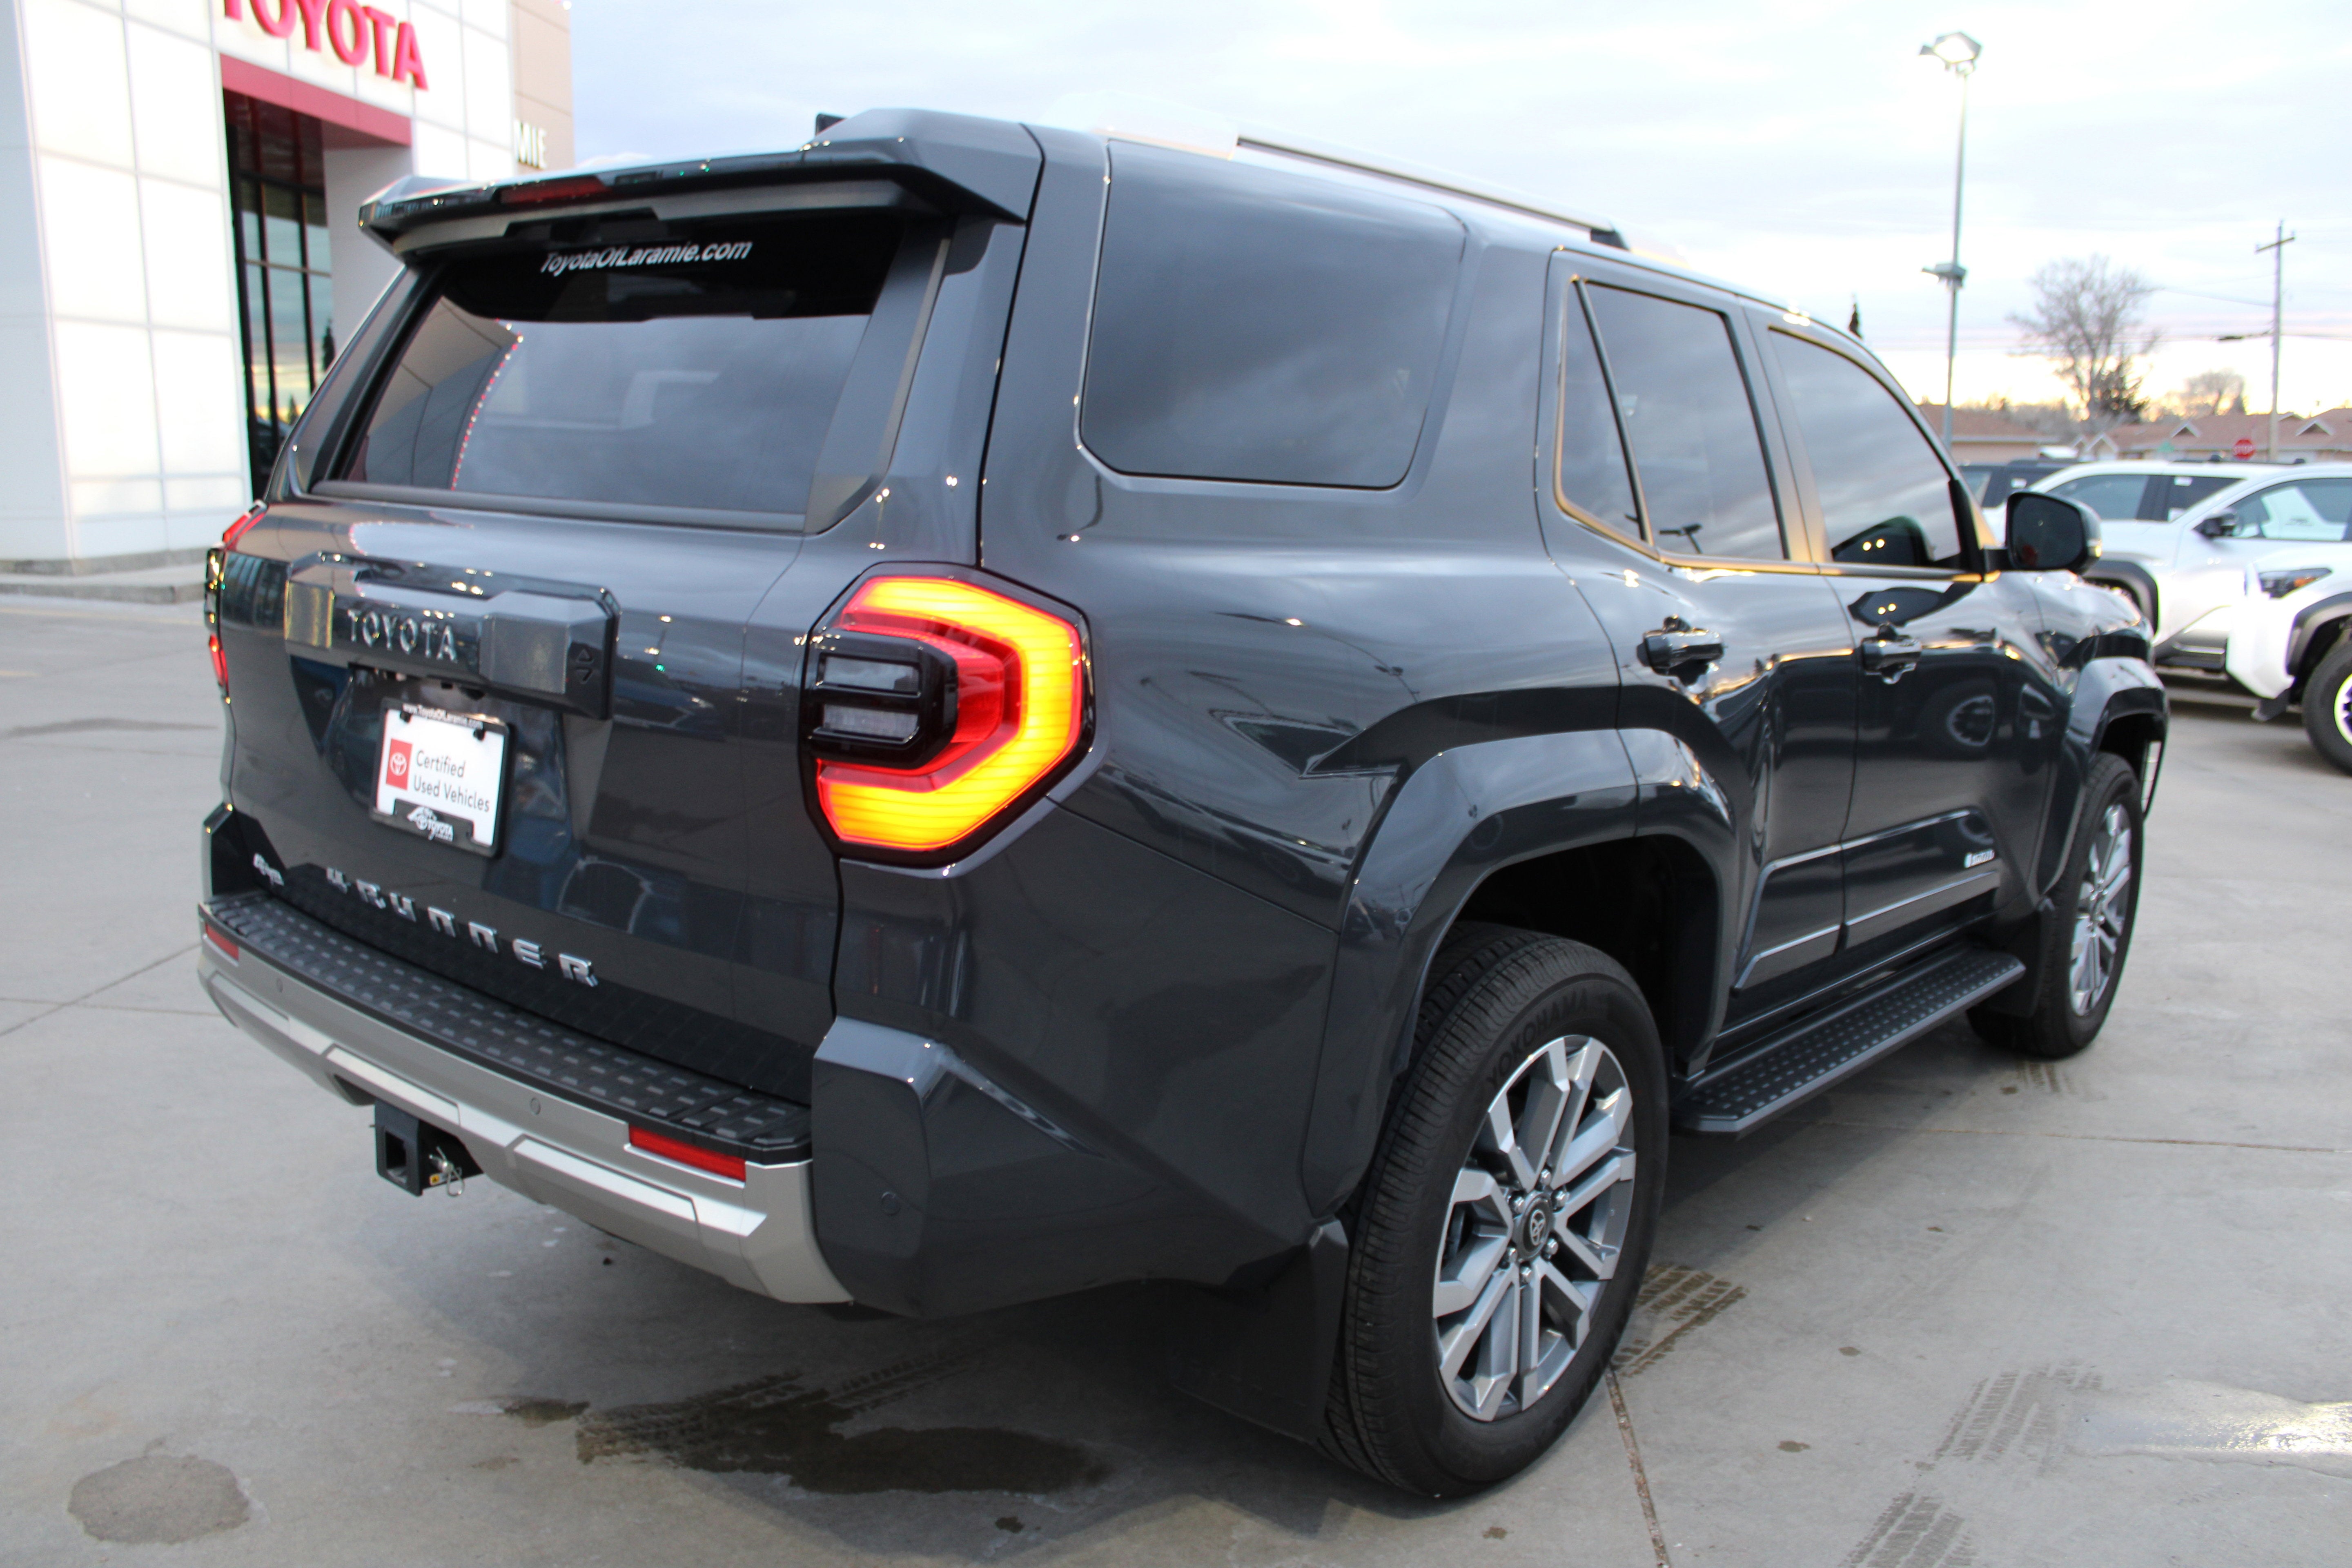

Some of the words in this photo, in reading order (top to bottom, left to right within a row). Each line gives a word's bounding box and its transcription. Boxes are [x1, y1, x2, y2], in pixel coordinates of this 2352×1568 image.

[541, 241, 753, 277] ToyotaOfLaramie.com
[2234, 445, 2253, 455] STOP
[347, 609, 458, 664] TOYOTA
[416, 750, 466, 777] Certified
[413, 775, 441, 797] Used
[445, 783, 490, 812] Vehicles
[1487, 989, 1589, 1088] YOKOHAMA
